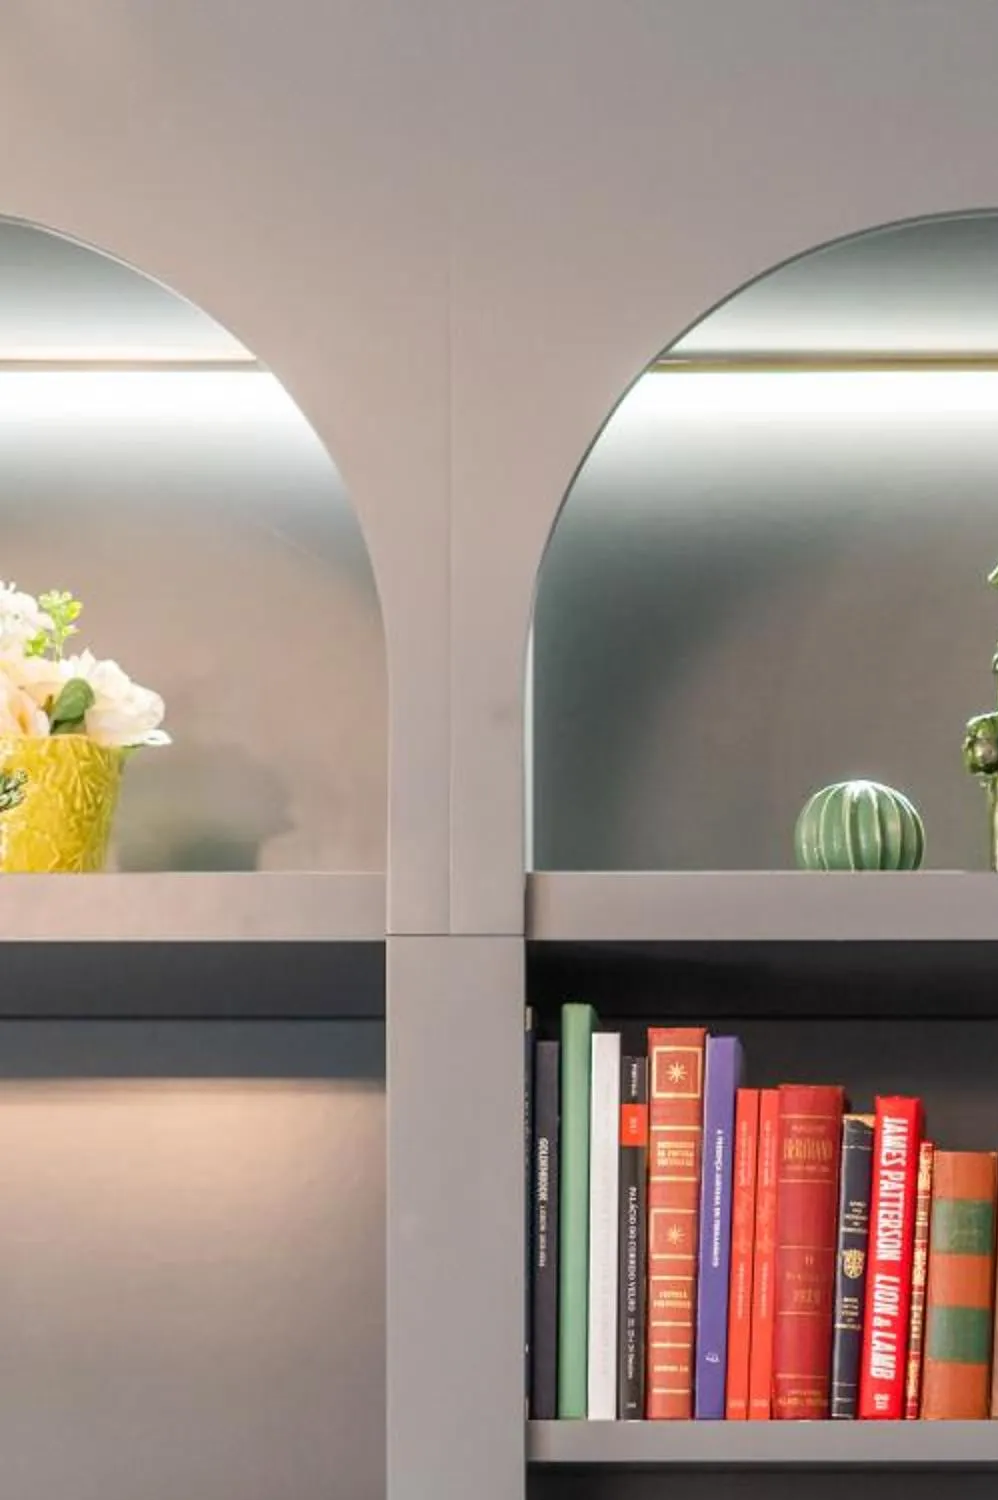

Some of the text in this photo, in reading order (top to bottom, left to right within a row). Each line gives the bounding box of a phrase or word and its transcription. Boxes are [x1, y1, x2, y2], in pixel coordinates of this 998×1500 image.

[875, 1116, 908, 1261] JAMES PATTERSON
[873, 1273, 900, 1317] LION
[870, 1330, 896, 1380] LAMB
